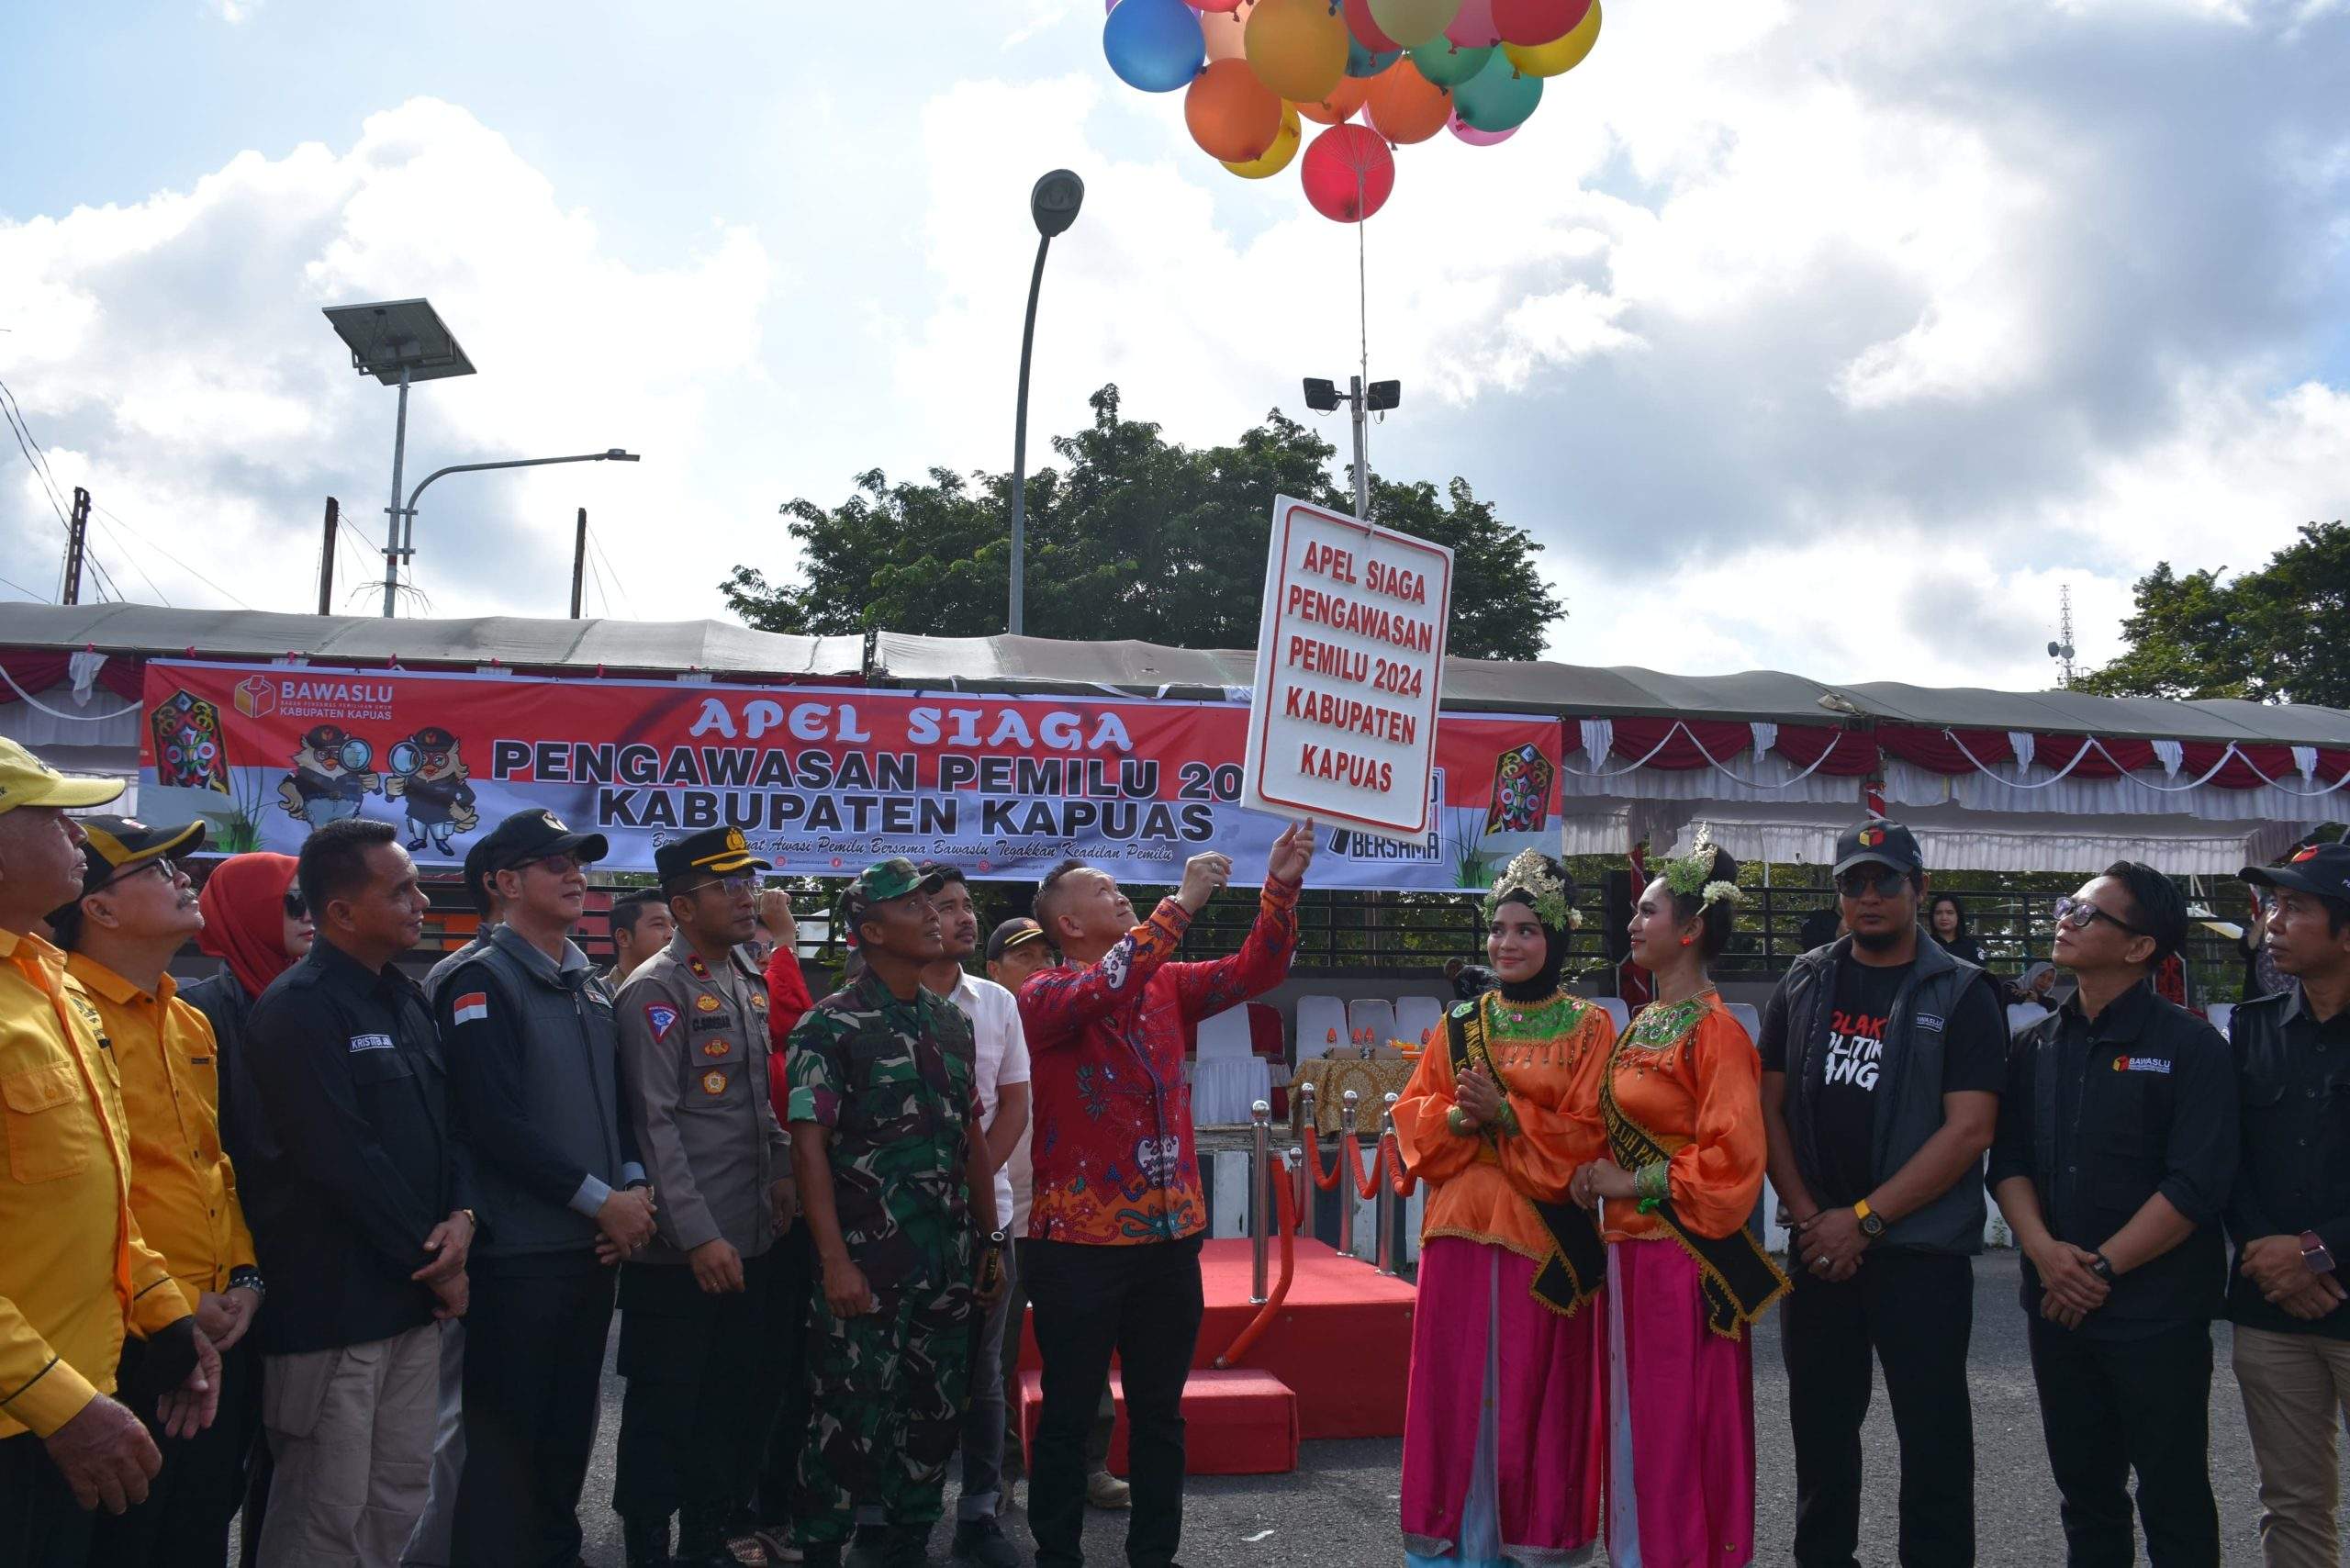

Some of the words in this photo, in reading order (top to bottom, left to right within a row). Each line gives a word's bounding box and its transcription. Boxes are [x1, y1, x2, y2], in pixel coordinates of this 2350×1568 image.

[1302, 540, 1357, 585] APEL
[1365, 559, 1426, 605] SIAGA
[1287, 583, 1433, 654] PENGAWASAN
[281, 681, 394, 703] BAWASLU
[1289, 634, 1370, 683] PEMILU
[1372, 657, 1423, 699] 2024
[280, 707, 344, 719] KABUPATEN
[347, 710, 393, 721] KAPUAS
[688, 697, 870, 743] APEL
[907, 706, 1134, 752] SIAGA
[1285, 685, 1417, 745] KABUPATEN
[492, 739, 918, 794] PENGAWASAN
[938, 752, 1160, 800] PEMILU
[1178, 761, 1244, 803] 20
[1300, 743, 1393, 793] KAPUAS
[597, 786, 960, 838] KABUPATEN
[980, 798, 1215, 844] KAPUAS
[768, 835, 812, 852] Awasi
[816, 835, 866, 854] Pemilu
[870, 836, 927, 855] Bersama
[933, 839, 990, 856] Bawaslu
[994, 839, 1058, 863] Tegakkan
[1060, 841, 1121, 860] Keadilan
[1125, 843, 1173, 861] Pemilu
[2129, 1058, 2171, 1068] BAWASLU
